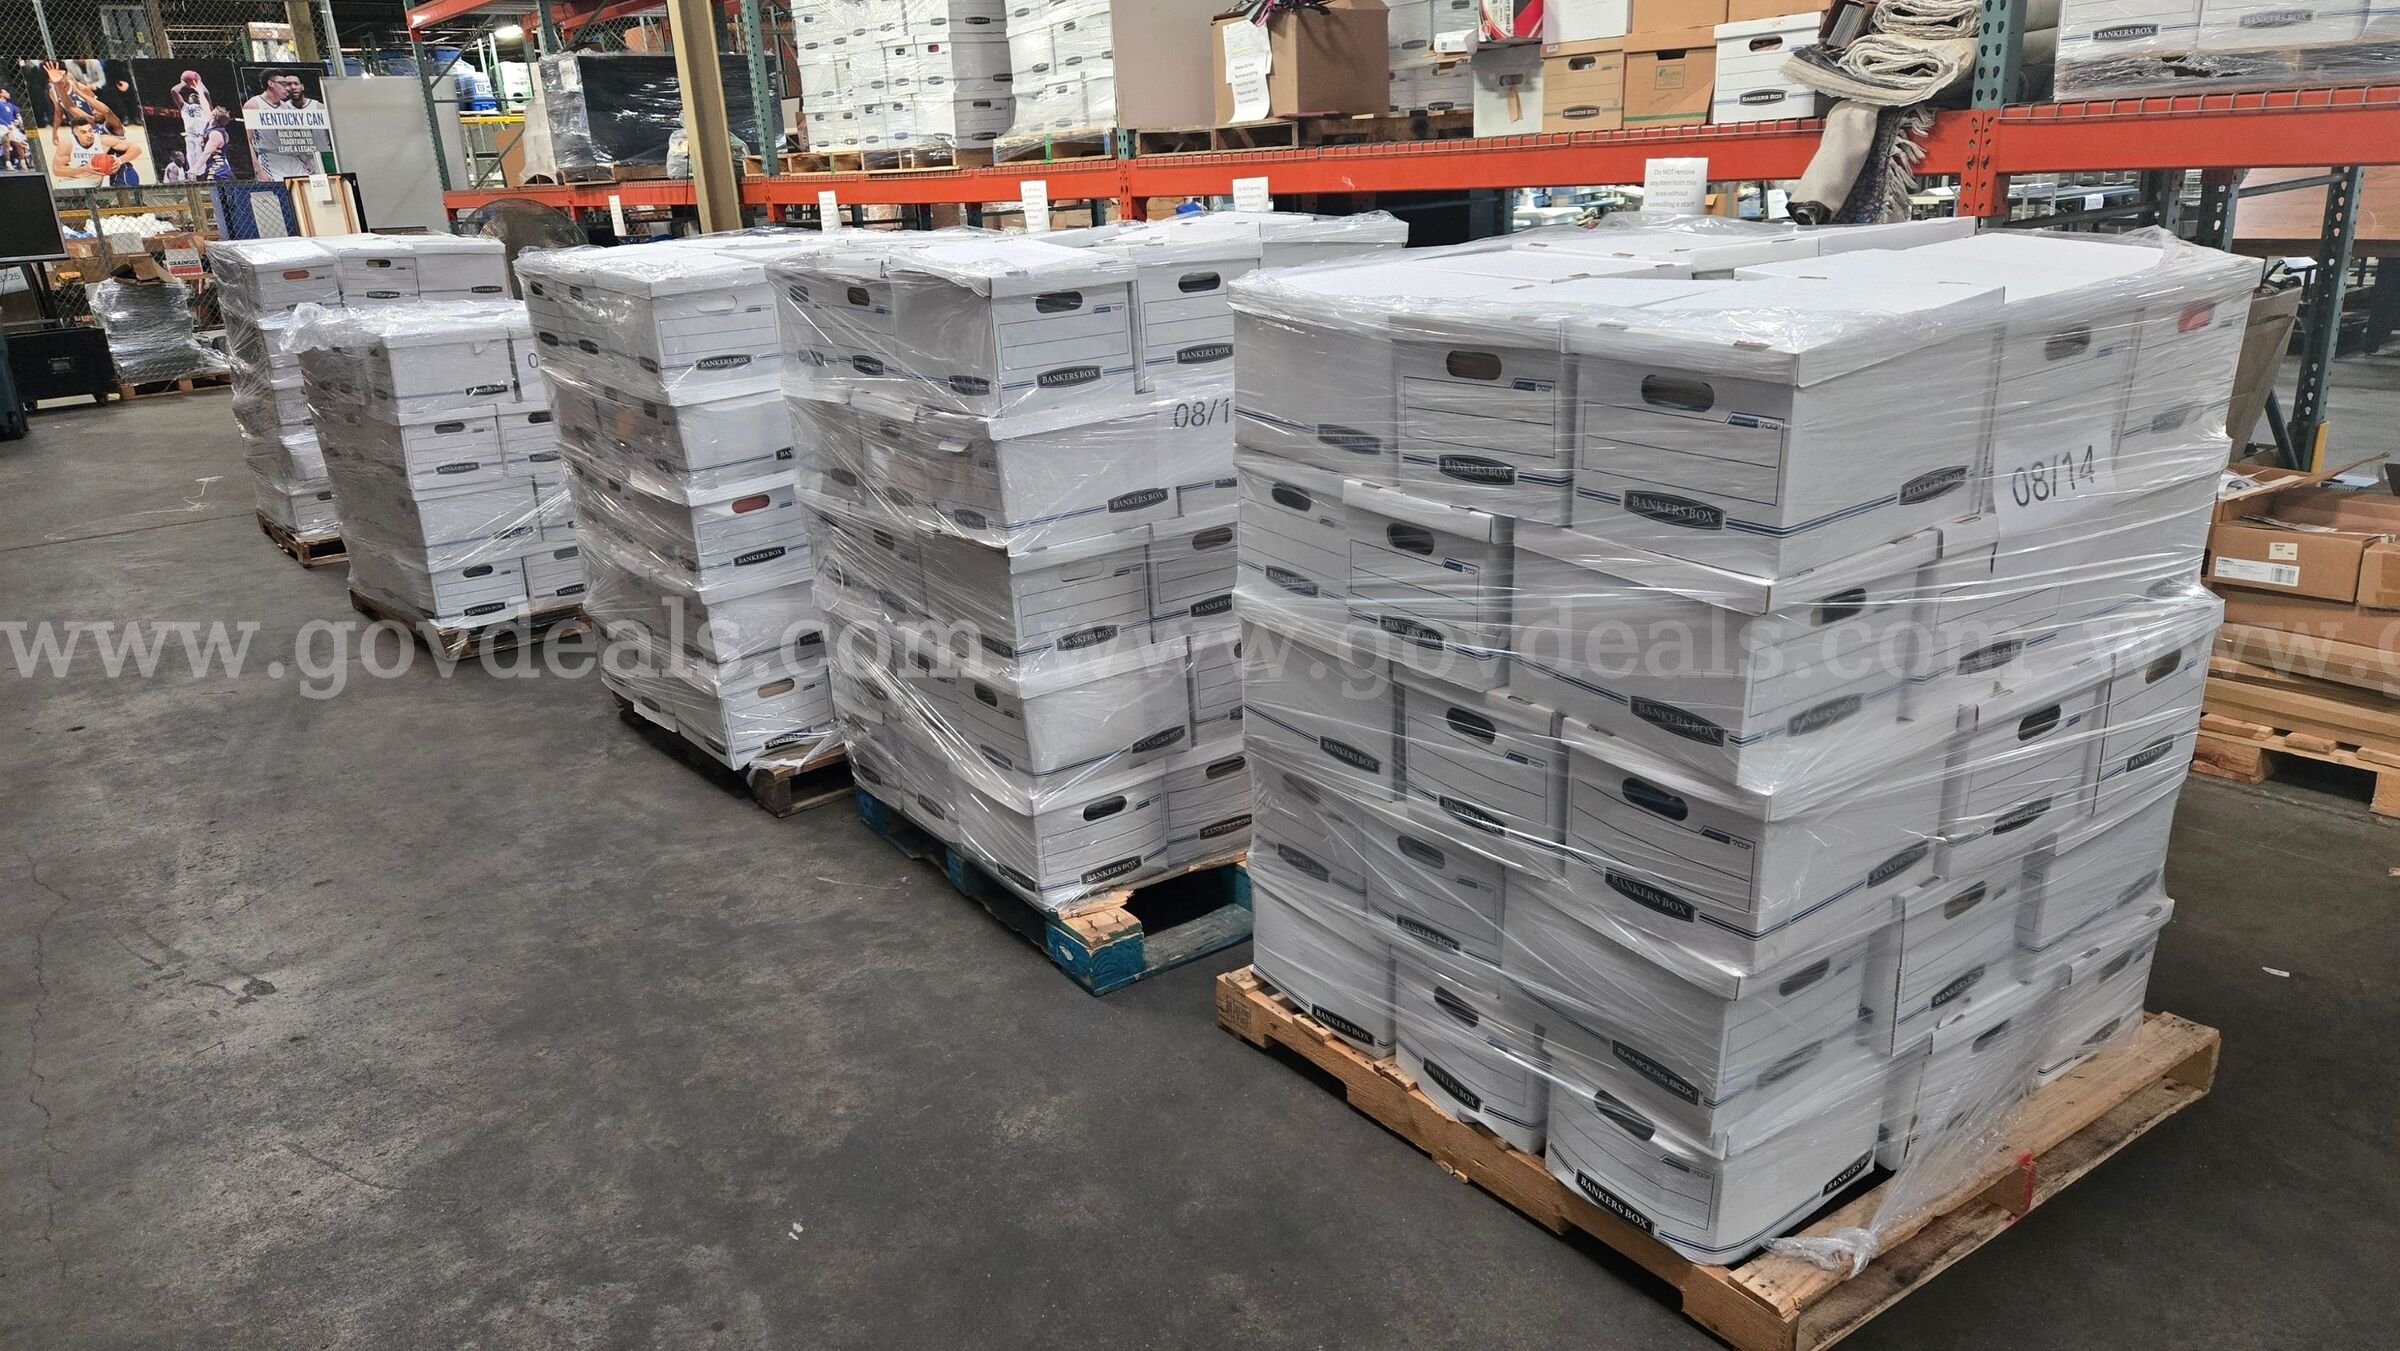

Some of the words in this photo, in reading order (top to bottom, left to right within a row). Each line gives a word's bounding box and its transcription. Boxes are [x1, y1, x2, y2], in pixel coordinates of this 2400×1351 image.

[2097, 27, 2135, 40] BANKERS
[2136, 25, 2153, 36] BOX
[1741, 93, 1768, 102] BANKERS
[1769, 92, 1783, 101] BOX
[259, 112, 305, 126] KENTUCKY
[306, 112, 325, 125] CAN
[278, 130, 293, 138] BUILD
[293, 130, 301, 138] ON
[301, 130, 312, 138] OUR
[700, 356, 732, 369] BANKERS
[732, 355, 748, 364] BOX
[1181, 349, 1214, 360] BANKERS
[1215, 346, 1230, 356] BOX
[1041, 370, 1079, 384] BANKERS
[1080, 368, 1097, 379] BOX
[1445, 459, 1488, 476] BANKERS
[1489, 466, 1508, 480] BOX
[2012, 444, 2095, 507] 08/14
[1113, 496, 1147, 510] BANKERS
[1148, 491, 1164, 502] BOX
[1632, 494, 1686, 517] BANKERS
[1689, 506, 1716, 523] BOX
[737, 551, 768, 565] BANKERS
[768, 549, 783, 559] BOX
[1195, 600, 1227, 613] BANKERS
[1060, 632, 1096, 647] BANKERS
[1097, 627, 1113, 639] BOX
[1639, 702, 1689, 728] BANKERS
[1691, 720, 1716, 738] BOX
[1323, 740, 1358, 762] BANKERS
[1359, 755, 1375, 770] BOX
[1086, 865, 1121, 883] BANKERS
[1122, 859, 1138, 871] BOX
[1611, 874, 1660, 905] BANKERS
[1662, 897, 1687, 916] BOX
[1316, 1007, 1352, 1032] BANKERS
[1352, 1026, 1371, 1042] BOX
[1617, 1048, 1668, 1082] BANKERS
[1669, 1078, 1694, 1098] BOX
[1426, 1063, 1460, 1094] BANKERS
[1458, 1090, 1476, 1107] BOX
[1580, 1177, 1624, 1214] BANKERS
[1625, 1209, 1649, 1229] BOX
